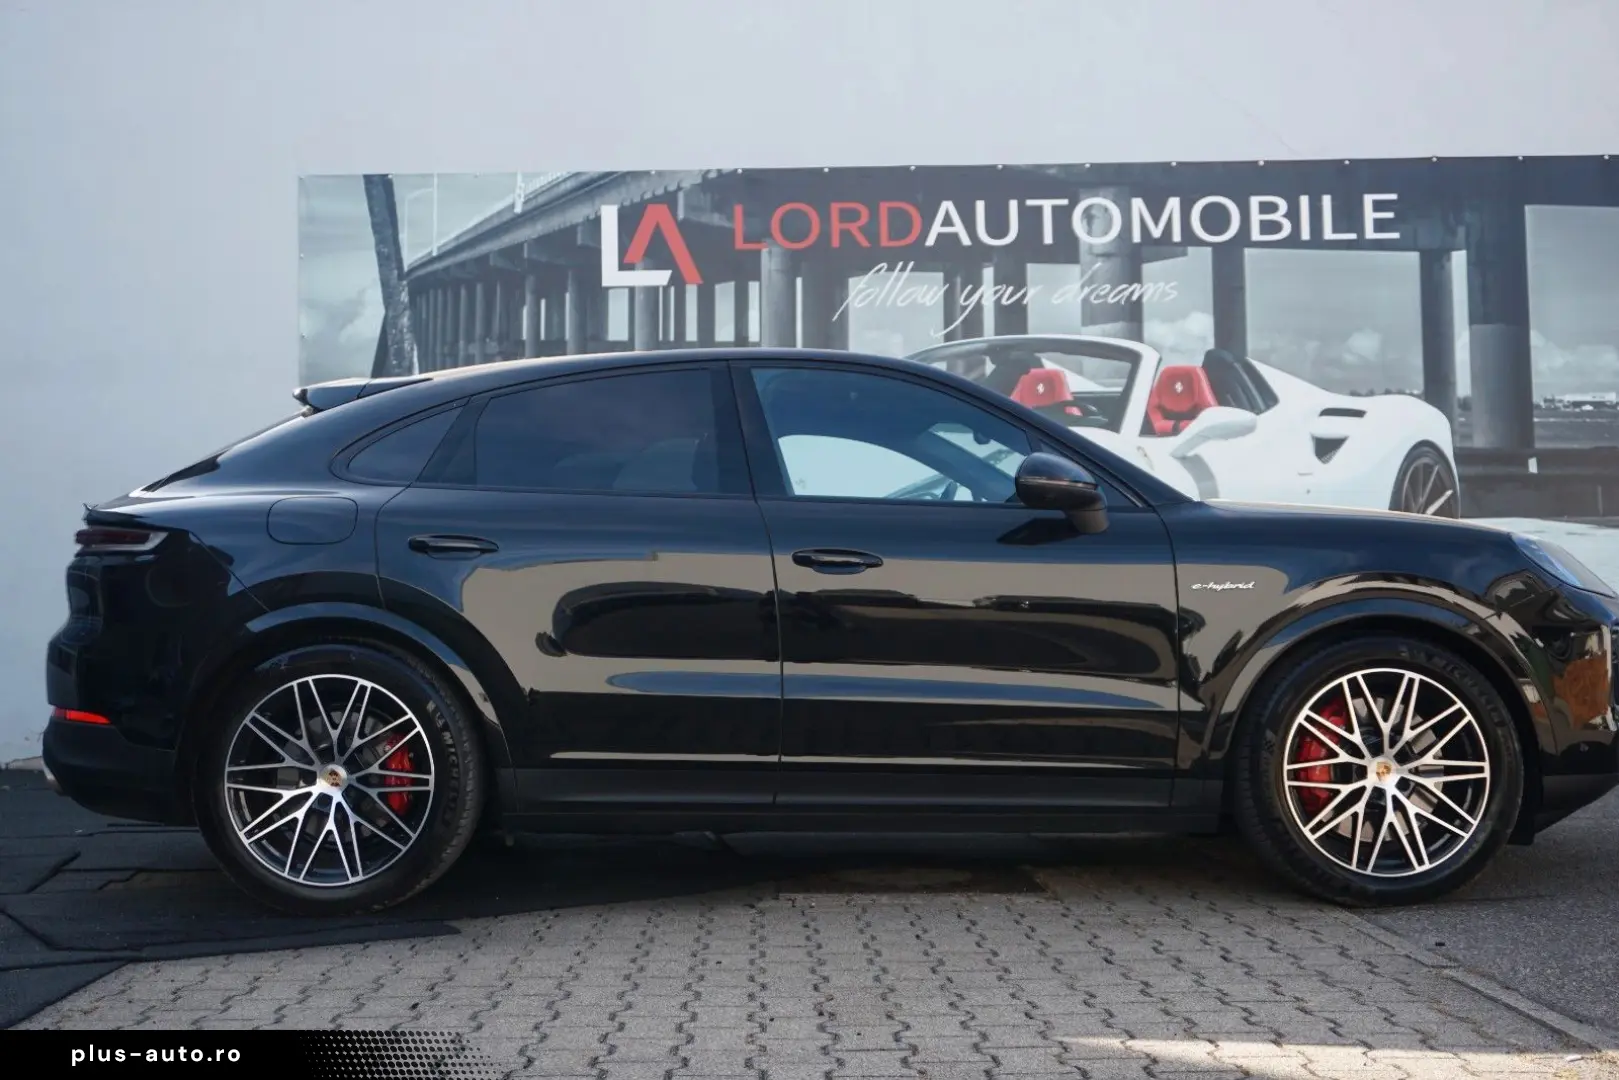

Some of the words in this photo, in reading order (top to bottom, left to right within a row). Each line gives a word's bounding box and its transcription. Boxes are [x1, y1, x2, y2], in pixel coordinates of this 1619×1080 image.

[600, 203, 704, 288] LA
[832, 260, 950, 322] follow
[930, 281, 1043, 339] your
[1051, 262, 1180, 305] dreams
[1191, 581, 1256, 592] e-hybrid
